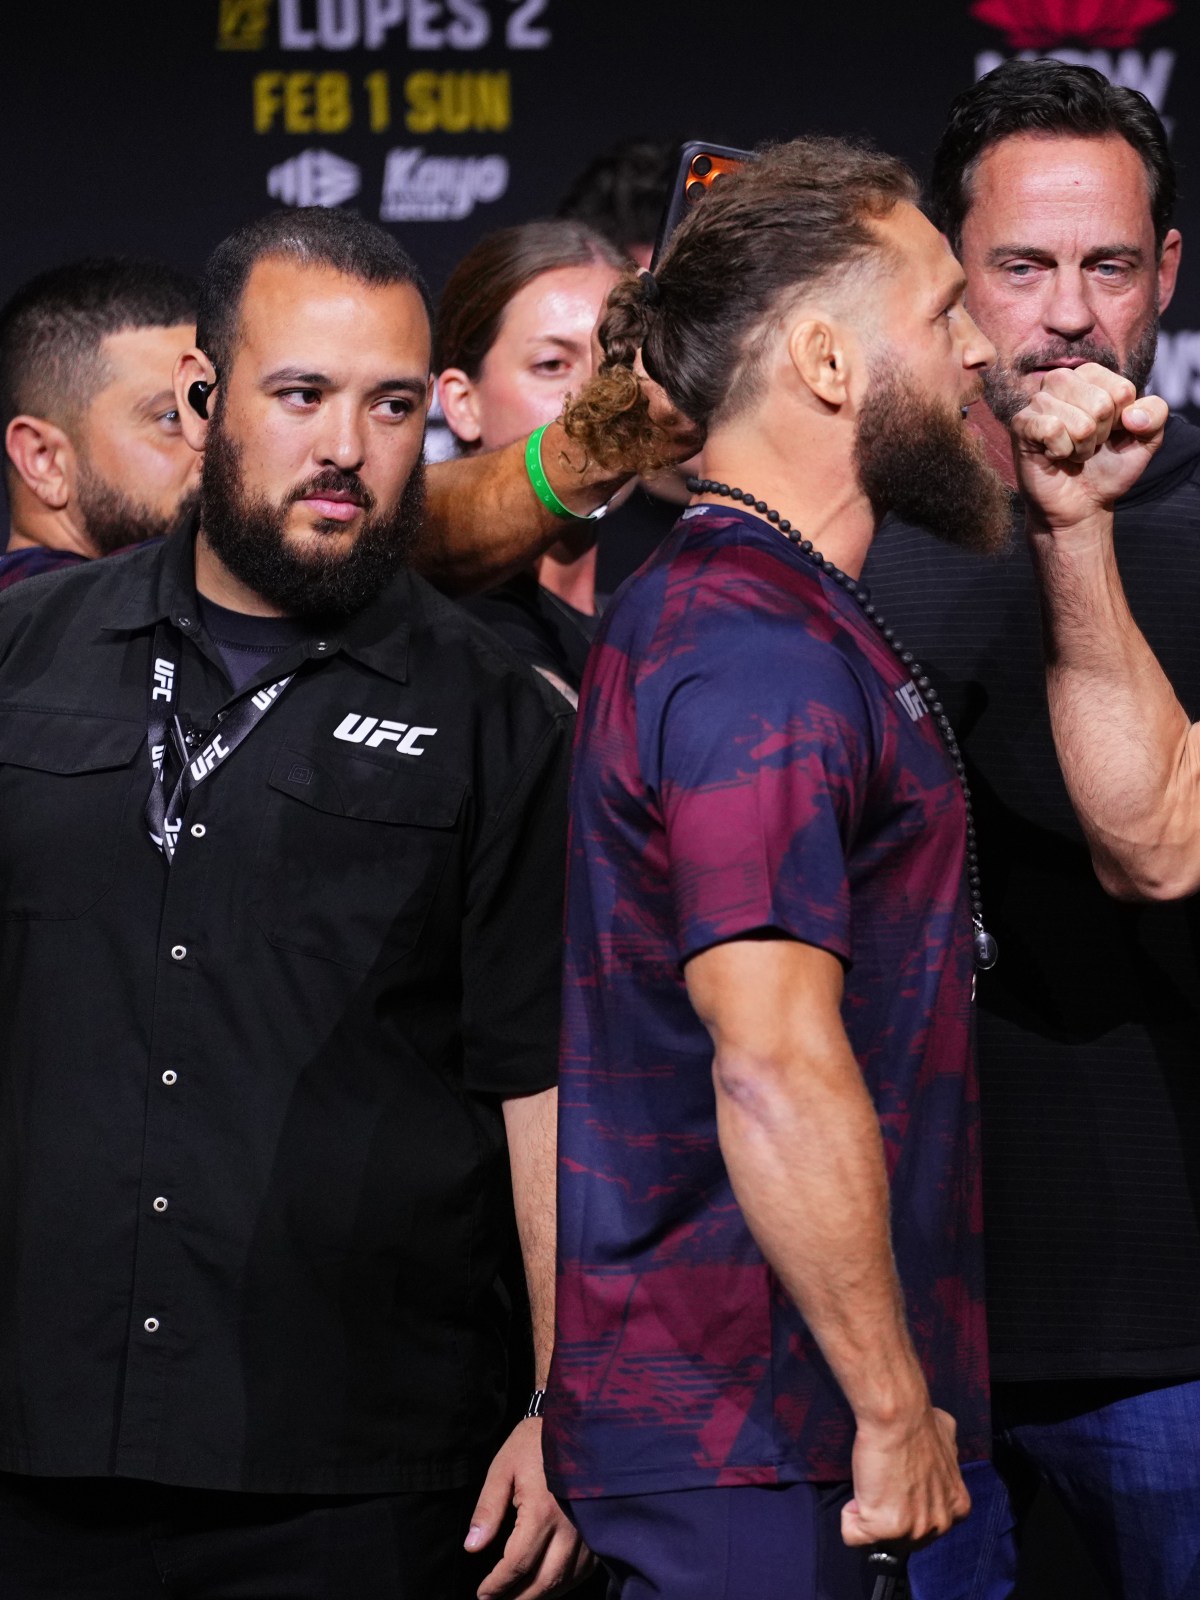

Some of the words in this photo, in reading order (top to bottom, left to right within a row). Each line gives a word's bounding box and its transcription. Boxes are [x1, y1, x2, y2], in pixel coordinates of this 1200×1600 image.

[505, 0, 552, 50] 2
[253, 69, 351, 134] FEB
[364, 69, 391, 134] 1
[405, 69, 513, 134] SUN
[381, 146, 511, 222] Kayo
[152, 658, 175, 702] UFC
[894, 680, 929, 722] UF
[190, 734, 230, 781] UFC
[333, 712, 438, 756] UFC
